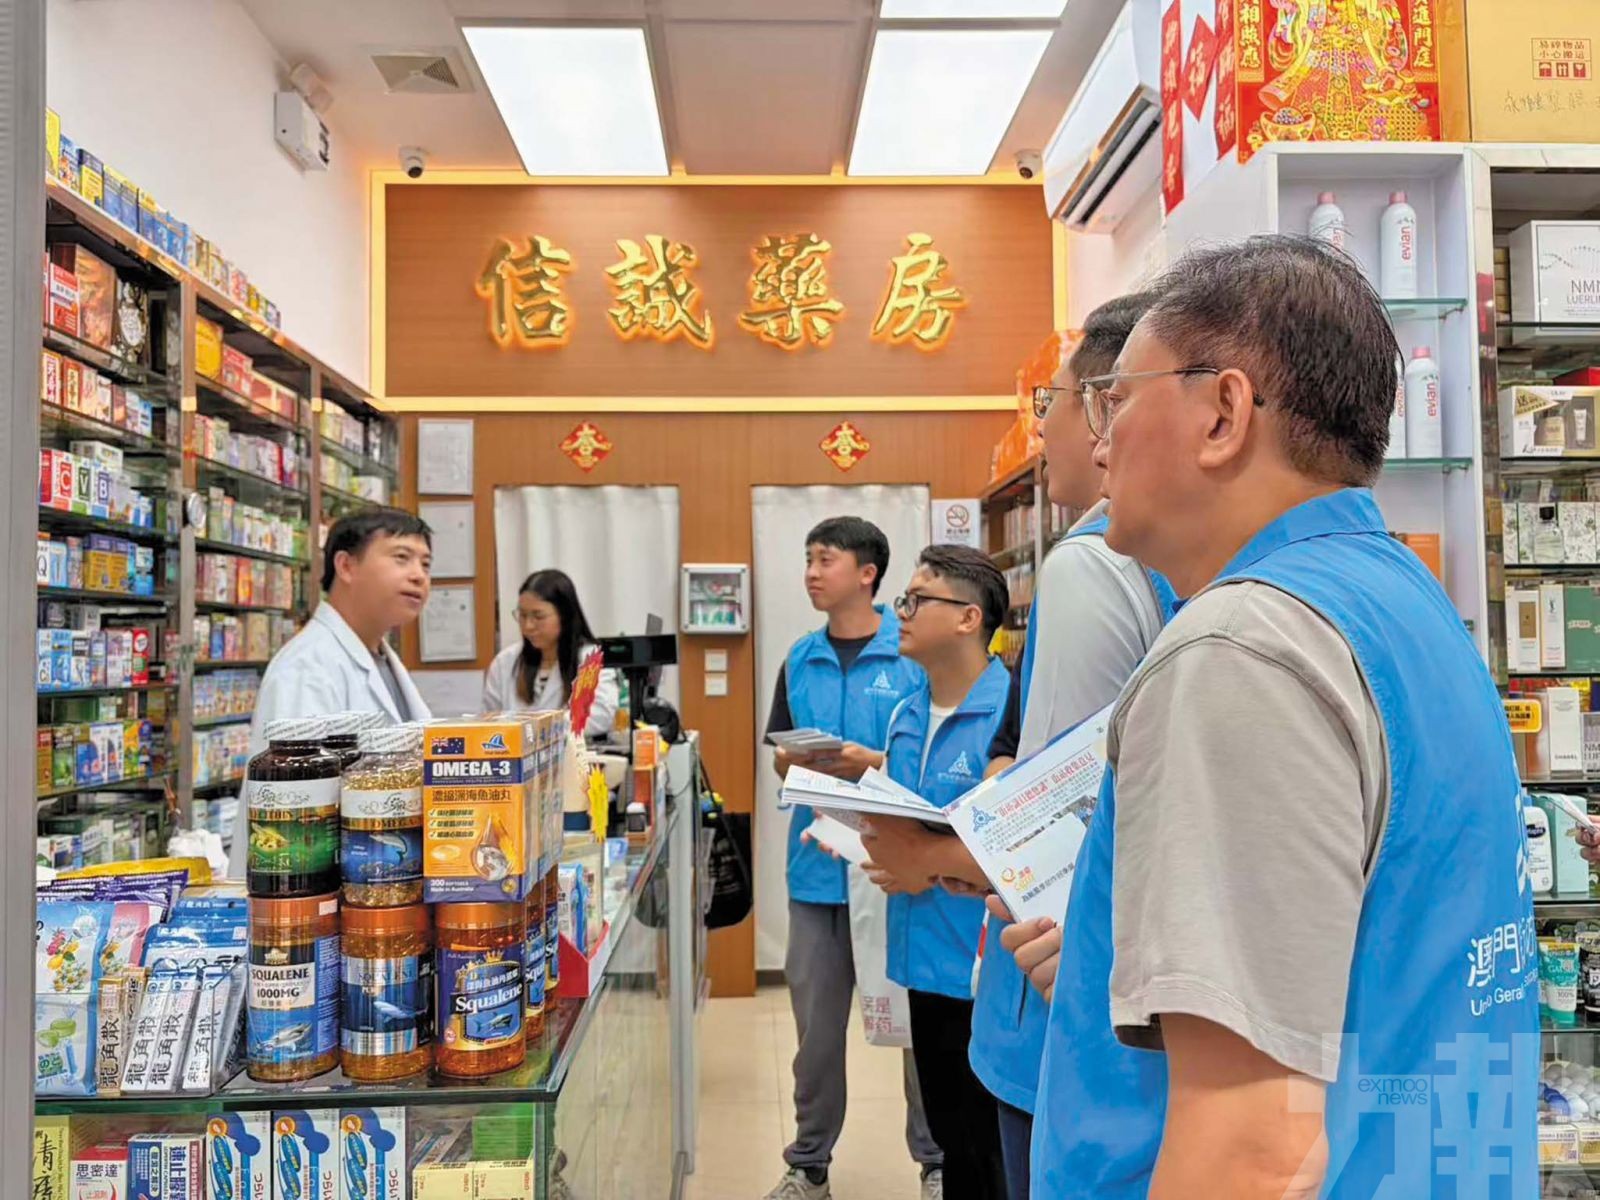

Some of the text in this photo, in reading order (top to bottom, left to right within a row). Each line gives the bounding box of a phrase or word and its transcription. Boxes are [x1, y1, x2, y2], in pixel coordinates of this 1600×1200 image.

[1239, 0, 1261, 69] 相照應
[1412, 0, 1436, 68] 進門庭
[1400, 226, 1412, 261] evian
[476, 232, 966, 350] 信誠藥房
[1426, 382, 1437, 417] evian
[561, 421, 613, 468] 春
[820, 421, 869, 468] 春
[60, 470, 72, 492] C
[79, 471, 90, 497] V
[432, 760, 511, 777] OMEGA-3
[252, 967, 310, 981] SQUALENE
[257, 987, 300, 999] 1000MG
[455, 982, 523, 1013] Squalene
[76, 1163, 118, 1178] 思密達
